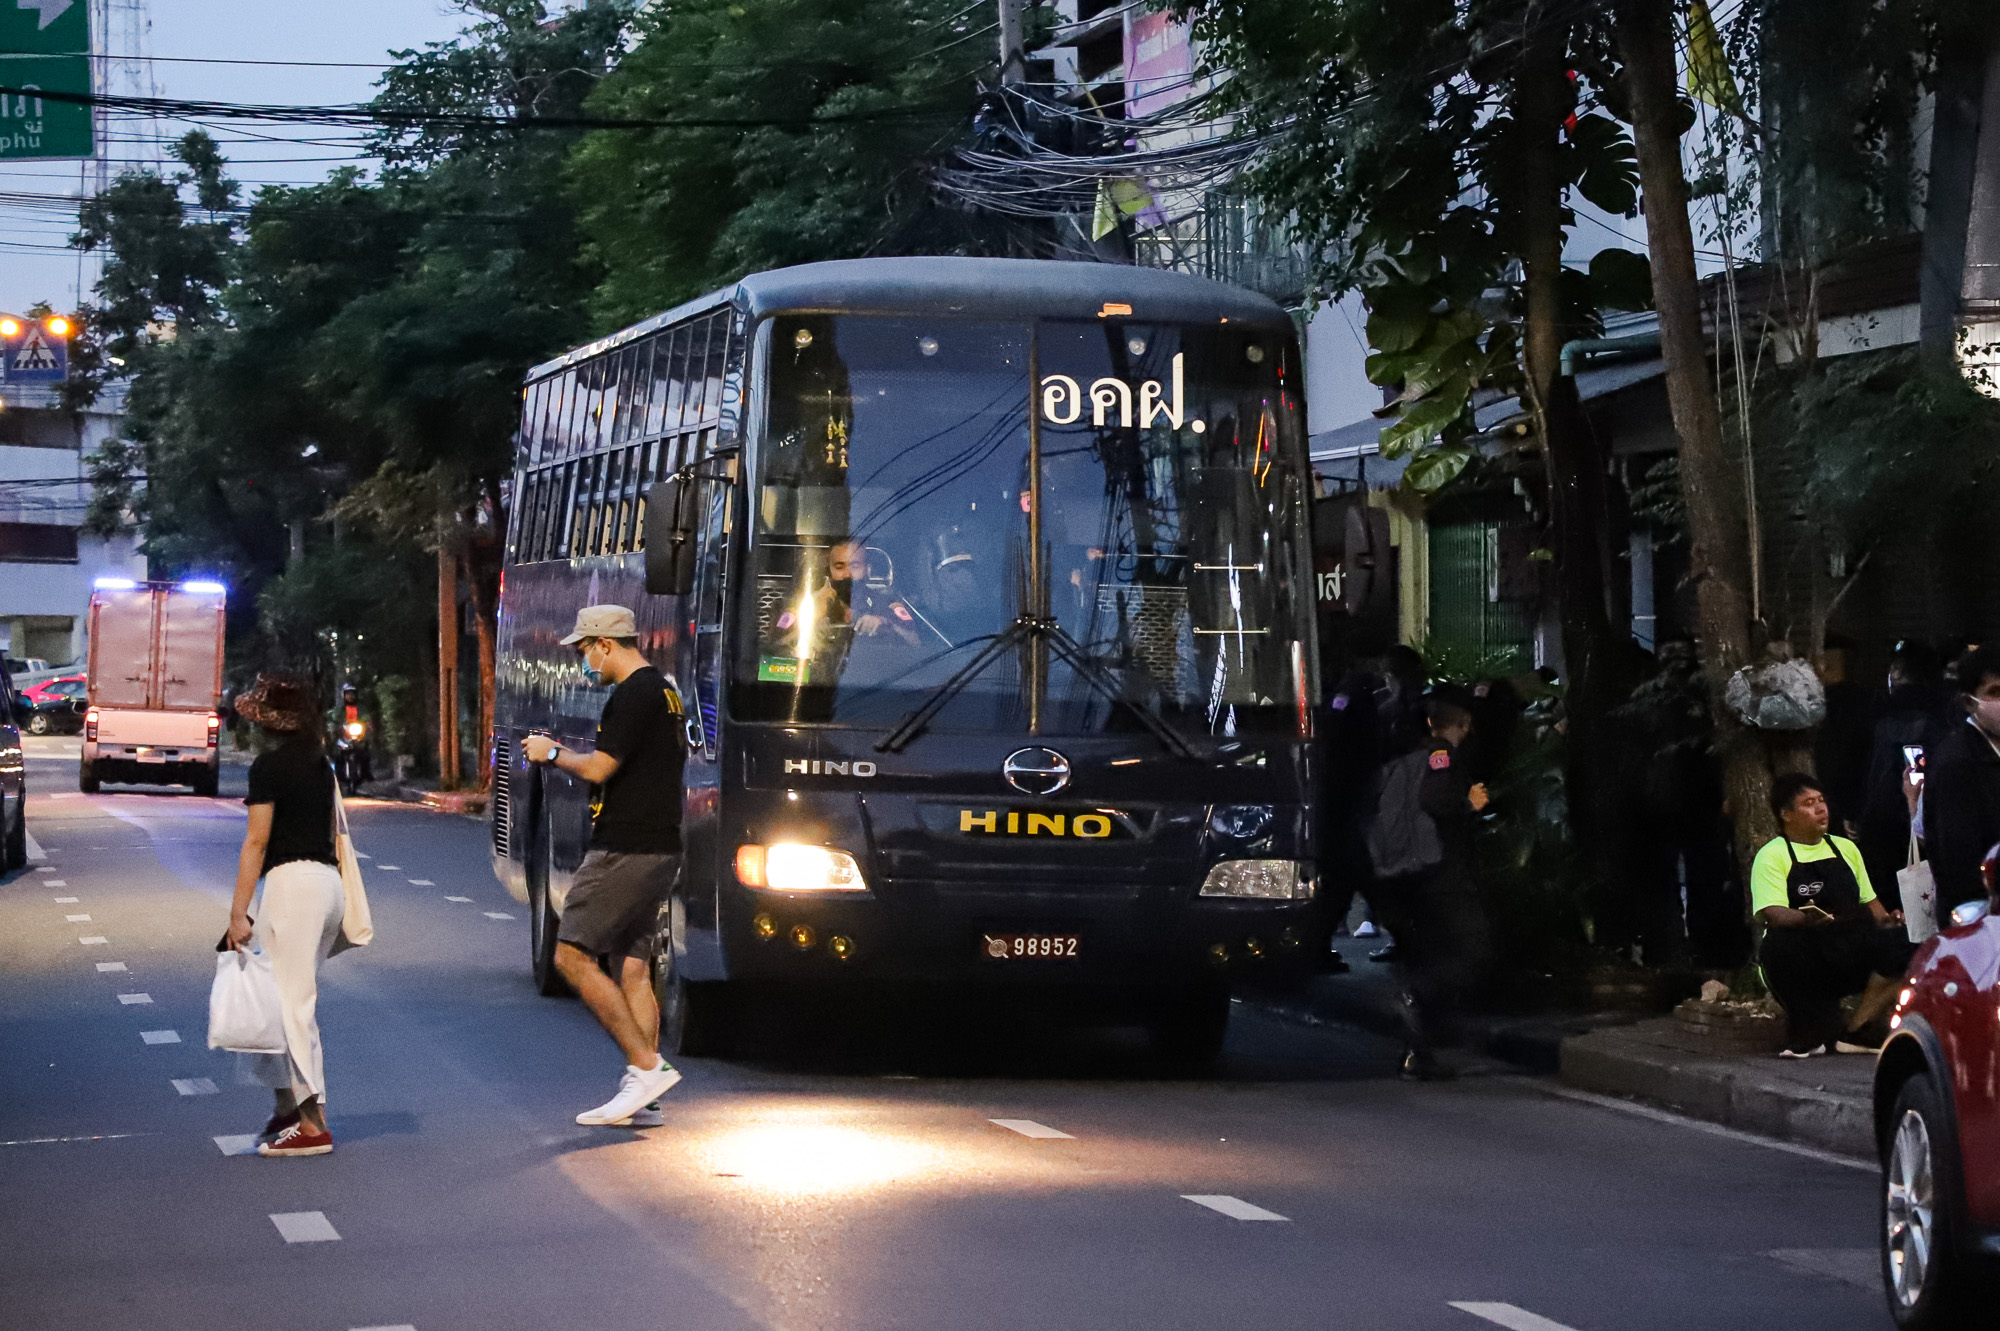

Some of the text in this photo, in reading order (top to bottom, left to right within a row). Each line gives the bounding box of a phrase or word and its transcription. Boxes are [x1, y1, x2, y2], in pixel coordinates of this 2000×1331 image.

[0, 133, 41, 153] phu
[1041, 352, 1206, 434] อคฝ.
[784, 759, 877, 777] HINO
[960, 809, 1112, 838] HINO
[1014, 937, 1077, 956] 98952
